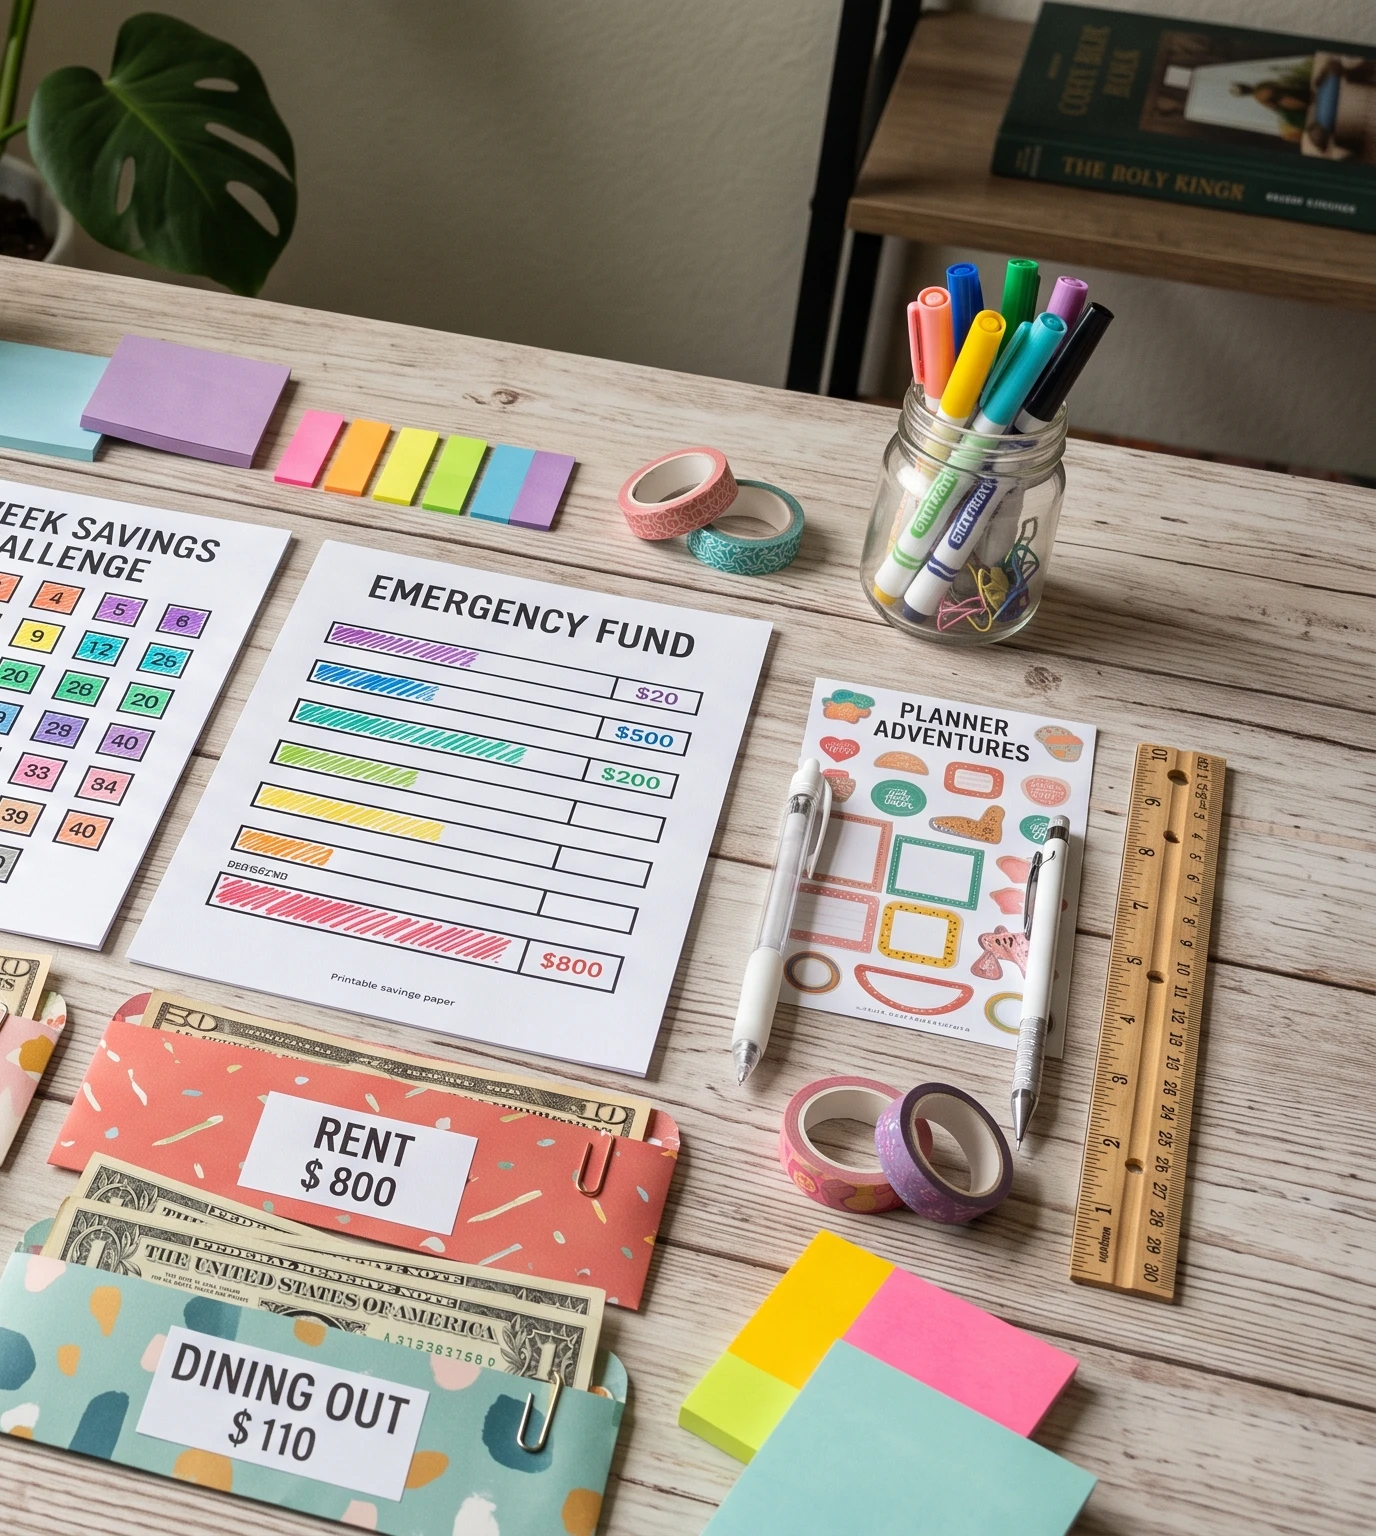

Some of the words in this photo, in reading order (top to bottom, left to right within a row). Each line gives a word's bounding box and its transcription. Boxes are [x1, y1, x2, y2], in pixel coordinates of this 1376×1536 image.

[1061, 156, 1106, 181] THE
[72, 515, 221, 563] SAVINGS
[49, 592, 64, 605] 4
[112, 603, 128, 616] 5
[368, 574, 589, 638] EMERGENCY
[595, 618, 695, 659] FUND
[30, 630, 45, 643] 9
[89, 641, 114, 657] 12
[1, 668, 29, 684] 20
[130, 693, 159, 709] 20
[635, 686, 679, 706] $20
[900, 701, 1010, 737] PLANNER
[111, 734, 139, 750] 40
[614, 725, 675, 749] $500
[873, 720, 1030, 763] ADVENTURES
[24, 763, 51, 780] 33
[600, 766, 661, 791] $200
[1, 807, 29, 825] 39
[68, 822, 97, 839] 40
[1138, 847, 1155, 857] 8
[1133, 901, 1149, 910] 7
[539, 951, 604, 979] $800
[1177, 962, 1190, 976] 10
[330, 972, 378, 992] Printable
[423, 993, 456, 1009] paper
[1174, 985, 1188, 999] 11
[314, 1116, 416, 1168] RENT
[1103, 1138, 1121, 1149] 2
[300, 1159, 321, 1192] $
[328, 1168, 397, 1208] 800
[1095, 1206, 1112, 1216] 1
[194, 1239, 297, 1269] FEDERAL
[401, 1286, 458, 1308] NOTE
[144, 1244, 190, 1269] THE
[195, 1256, 276, 1290] UNITED
[277, 1277, 359, 1307] STATES
[363, 1298, 392, 1317] OF
[390, 1304, 497, 1341] AMERICA
[170, 1343, 314, 1412] DINING
[326, 1381, 411, 1434] OUT
[228, 1409, 250, 1446] $
[260, 1417, 317, 1462] 110
